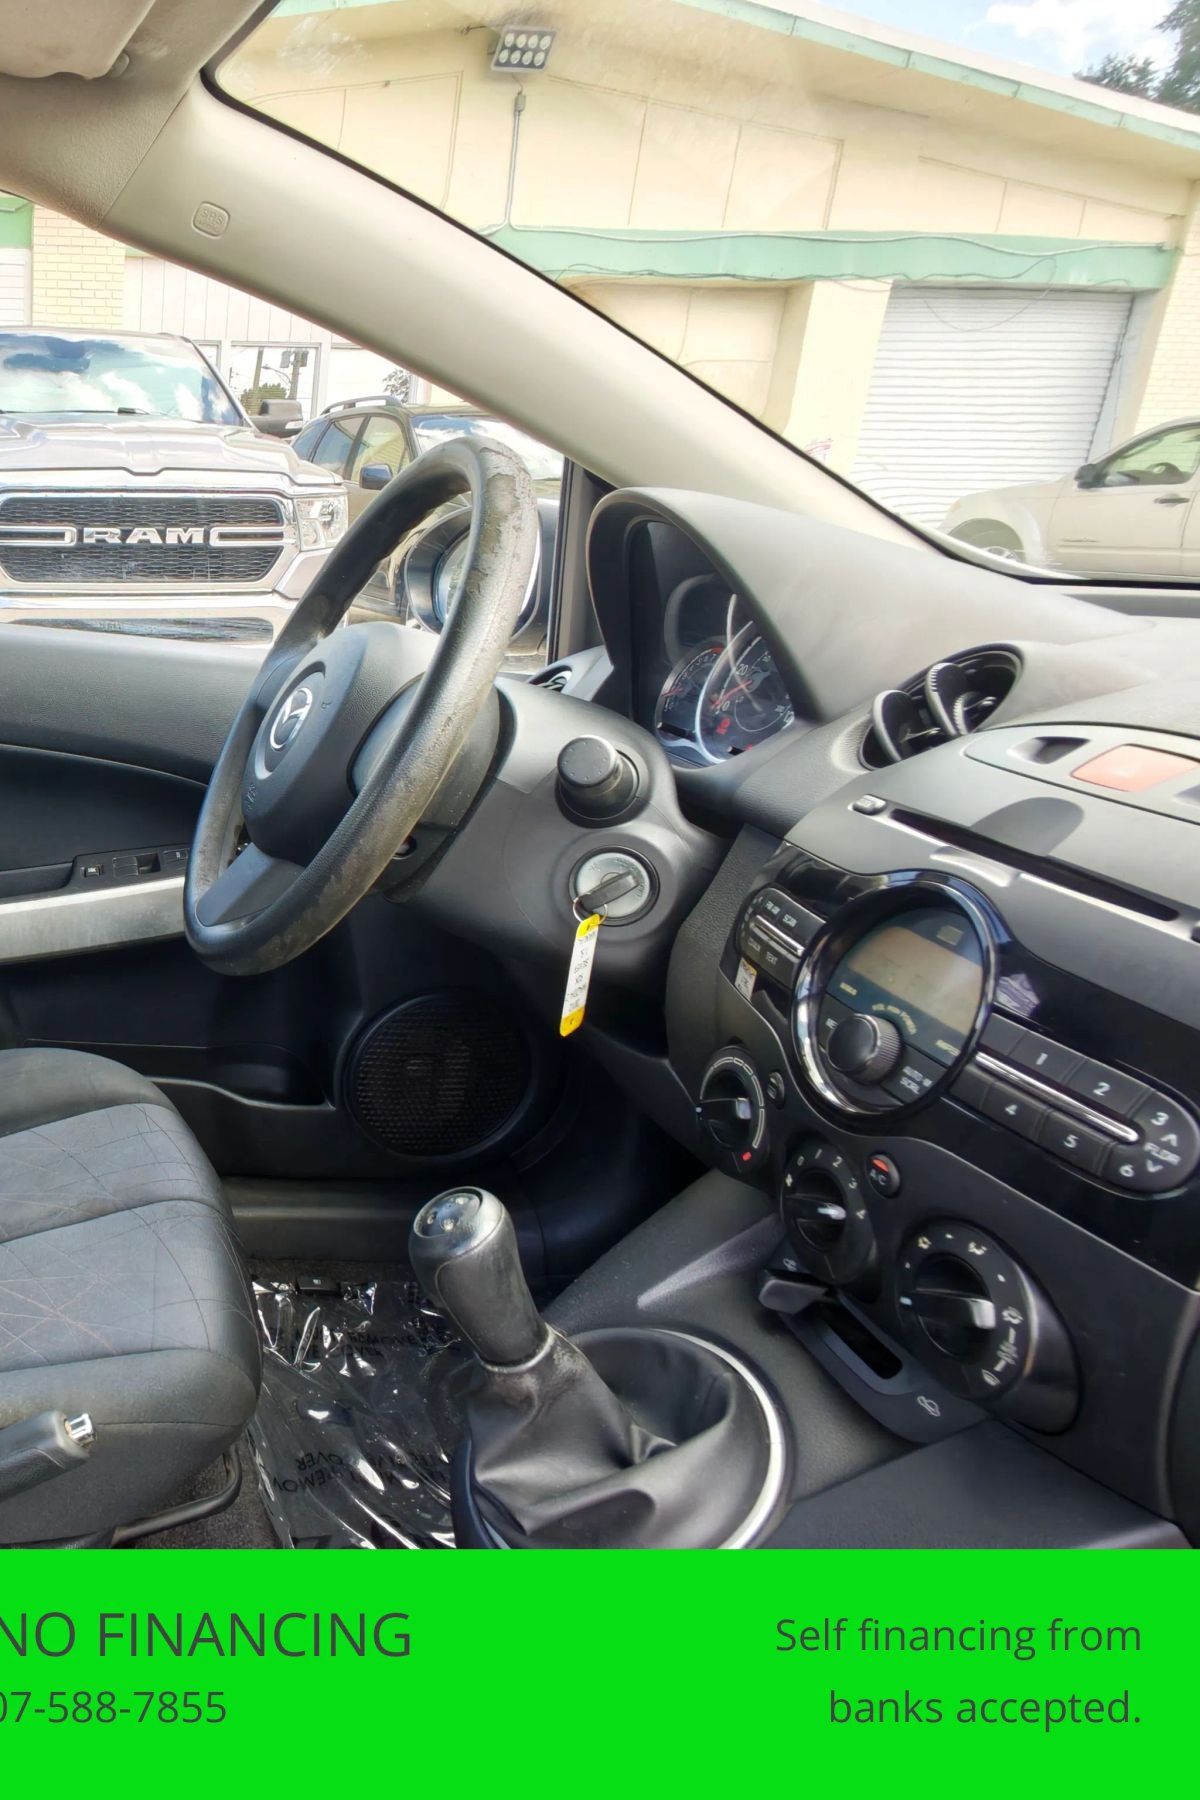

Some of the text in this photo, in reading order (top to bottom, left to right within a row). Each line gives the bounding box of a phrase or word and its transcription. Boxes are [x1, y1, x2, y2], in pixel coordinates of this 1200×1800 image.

[83, 527, 205, 545] RAM
[1035, 1052, 1049, 1066] 1
[1092, 1081, 1111, 1097] 2
[1004, 1103, 1019, 1116] 4
[1150, 1111, 1170, 1127] 3
[1063, 1133, 1080, 1149] 5
[831, 1155, 844, 1168] 2
[1118, 1163, 1135, 1178] 6
[848, 1177, 858, 1189] 3
[297, 1451, 344, 1472] OVER
